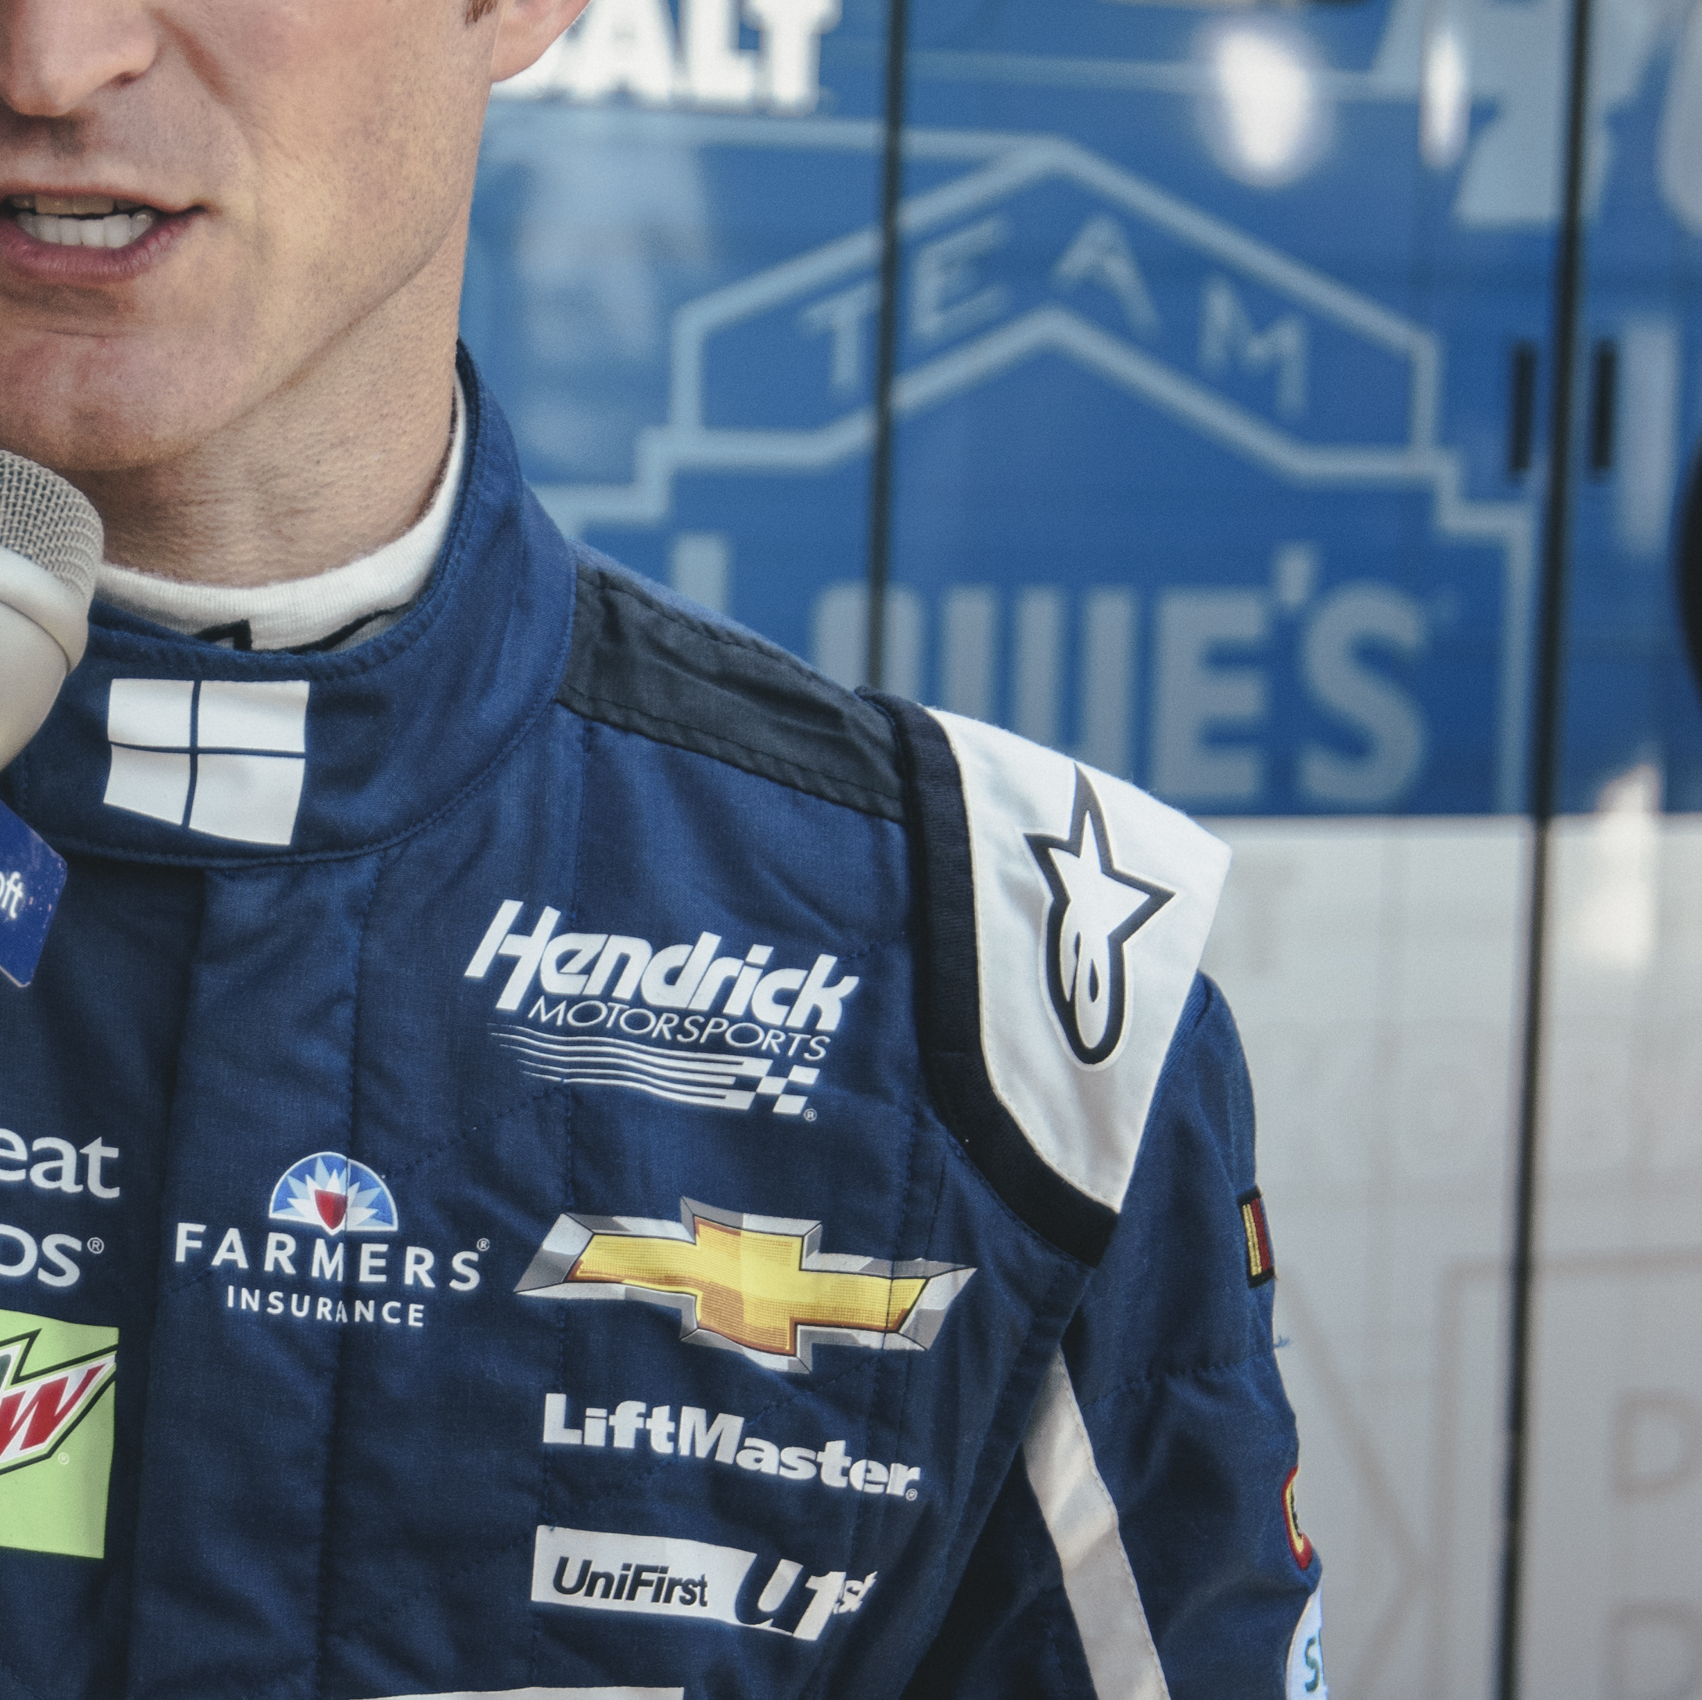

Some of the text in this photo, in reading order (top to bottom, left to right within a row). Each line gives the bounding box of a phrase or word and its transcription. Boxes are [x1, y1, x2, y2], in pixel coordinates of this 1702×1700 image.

[795, 210, 1306, 414] TEAM
[464, 899, 860, 1032] Hendrick
[527, 995, 831, 1061] MOTORSPORTS
[175, 1222, 481, 1292] FARMERS
[227, 1285, 424, 1327] INSURANCE
[543, 1392, 921, 1497] LiftMaster
[553, 1556, 709, 1608] UniFirst
